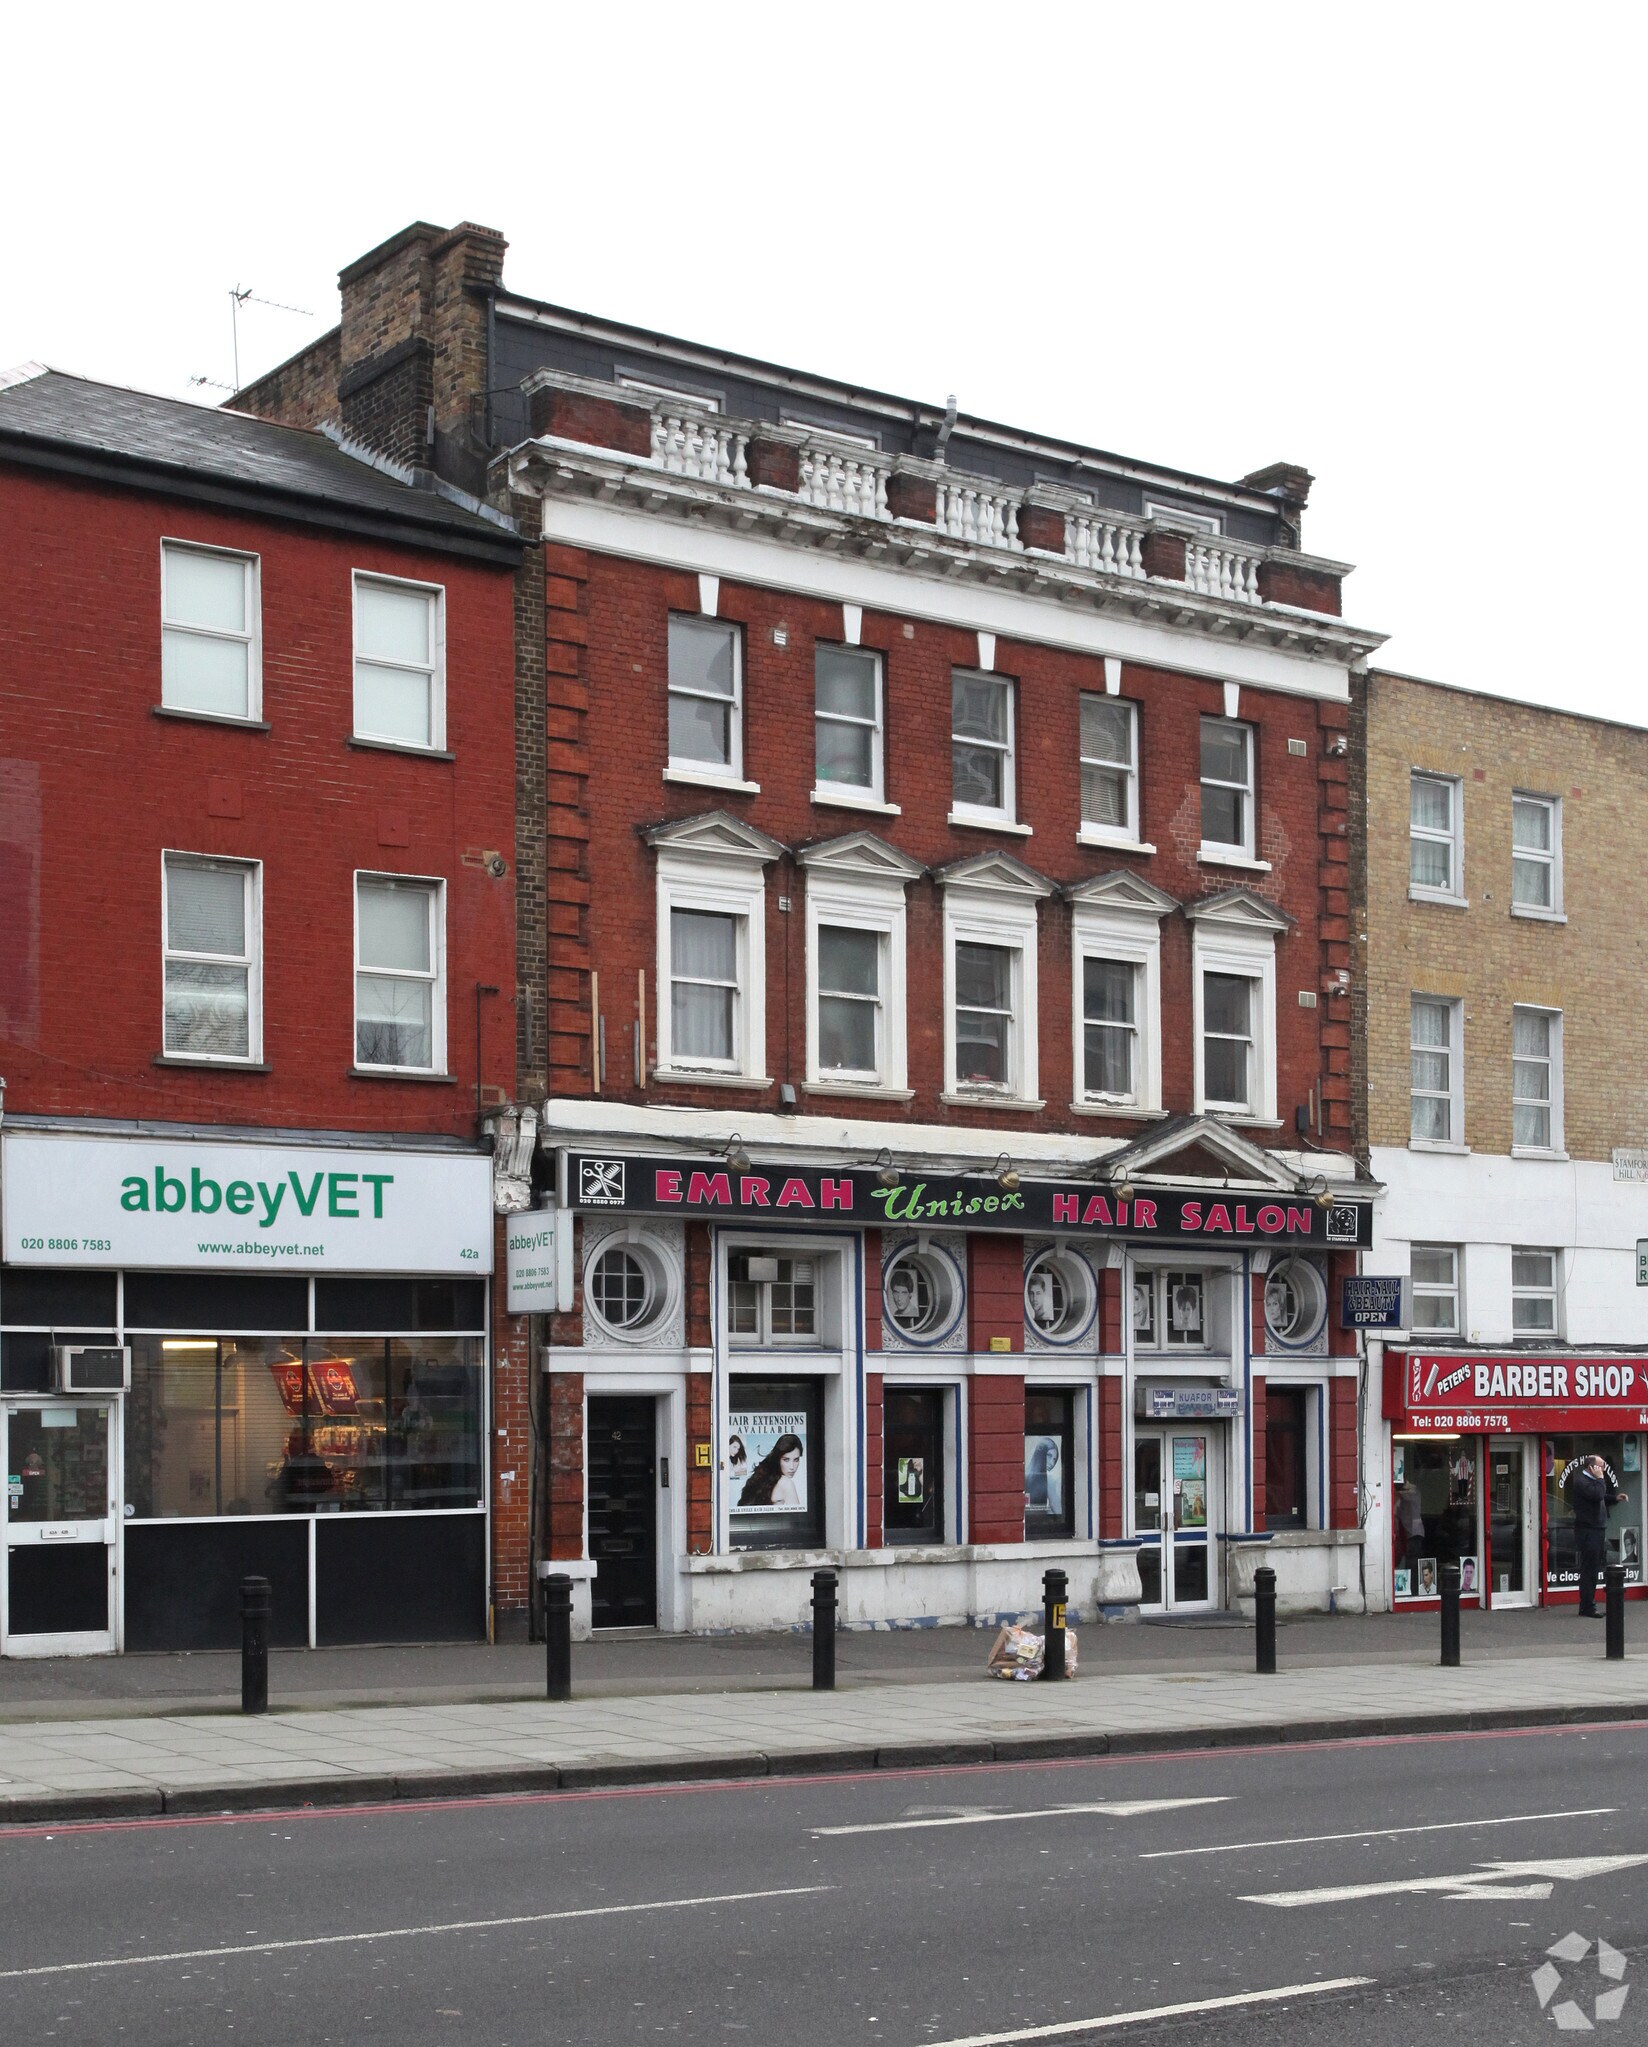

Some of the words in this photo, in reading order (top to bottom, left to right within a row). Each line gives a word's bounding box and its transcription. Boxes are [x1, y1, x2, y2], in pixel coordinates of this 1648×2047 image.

[120, 1165, 395, 1228] abbeyVET
[655, 1169, 853, 1210] EMRAH
[870, 1183, 1025, 1220] Unisex
[1052, 1193, 1157, 1229] HAIR
[1181, 1201, 1312, 1234] SALON
[21, 1238, 44, 1250] 020
[48, 1238, 78, 1250] 8806
[82, 1239, 112, 1251] 7583
[509, 1231, 554, 1252] abbeyVET
[197, 1241, 324, 1258] www.abbeyvet.net
[460, 1248, 479, 1260] 42a
[515, 1269, 525, 1278] 020
[525, 1268, 537, 1277] 8806
[537, 1267, 550, 1276] 7583
[1355, 1312, 1388, 1323] OPEN
[1437, 1363, 1472, 1396] PETER'S
[1473, 1364, 1569, 1398] BARBER
[1574, 1365, 1635, 1398] SHOP
[753, 1415, 805, 1426] EXTENSIONS
[1412, 1415, 1432, 1427] Tel:
[1434, 1416, 1454, 1428] 020
[1456, 1416, 1481, 1427] 8806
[1484, 1415, 1508, 1427] 7578
[1639, 1414, 1648, 1425] N
[611, 1430, 621, 1440] 42
[738, 1426, 795, 1434] AVAILABLE
